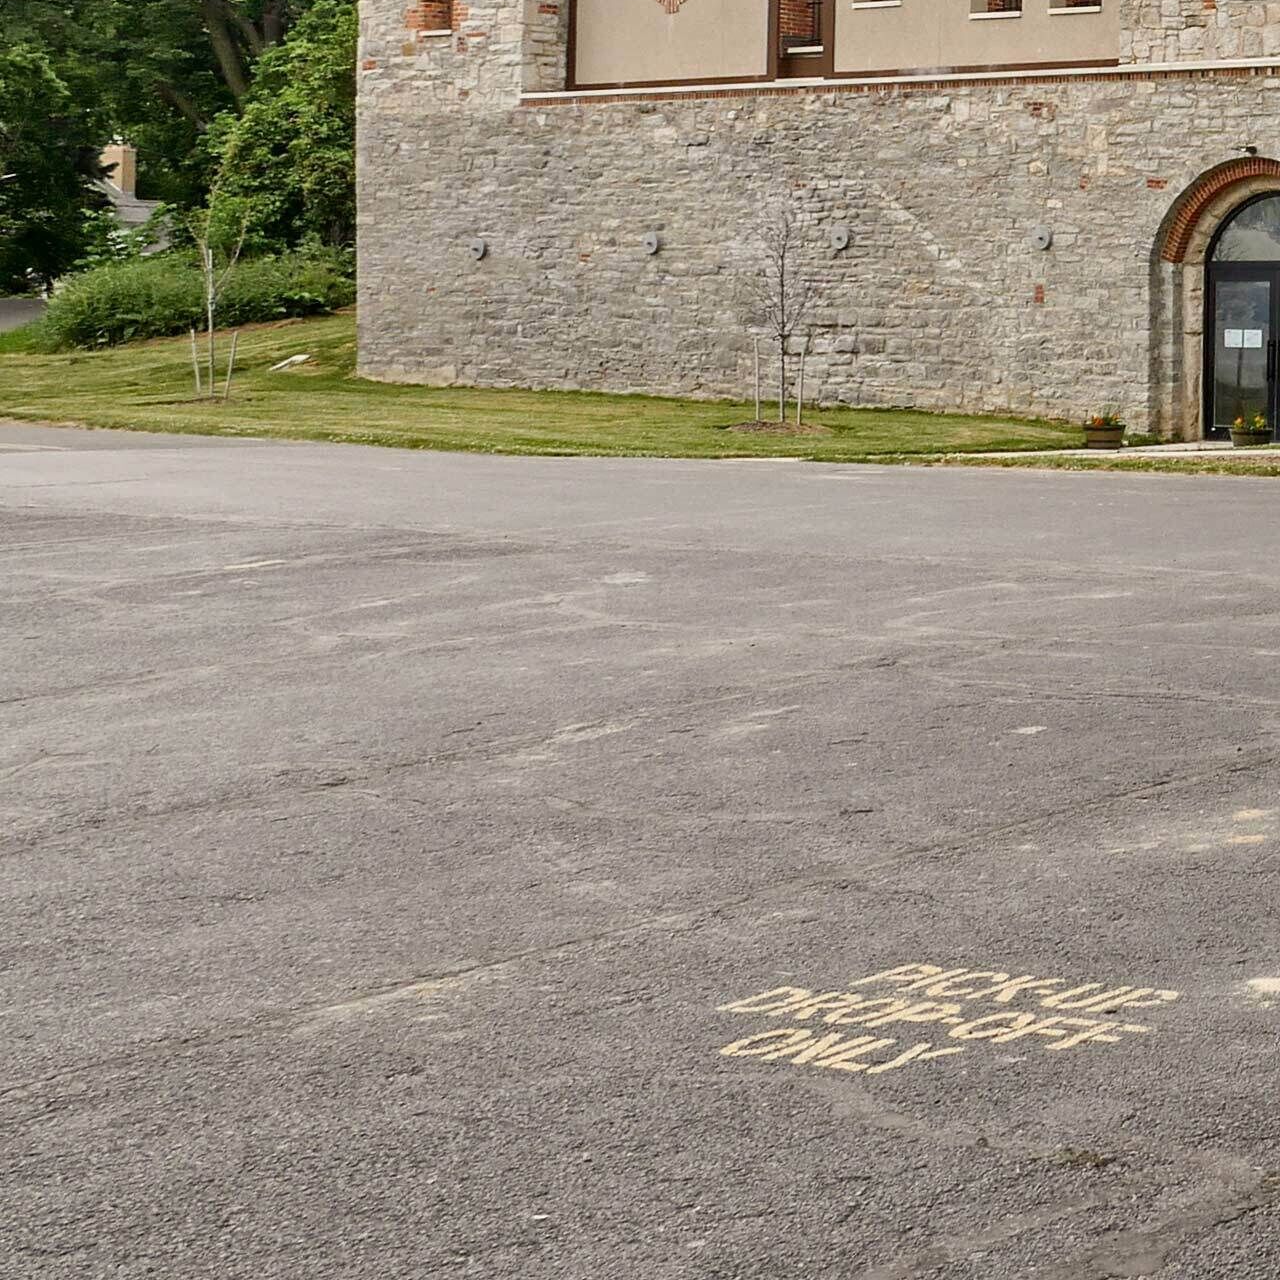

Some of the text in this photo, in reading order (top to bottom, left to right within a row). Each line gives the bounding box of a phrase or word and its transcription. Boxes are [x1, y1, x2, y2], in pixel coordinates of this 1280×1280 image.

[848, 963, 1179, 1012] PICK-UP
[714, 985, 1153, 1050] DROP-OFF
[719, 1028, 964, 1074] ONLY
